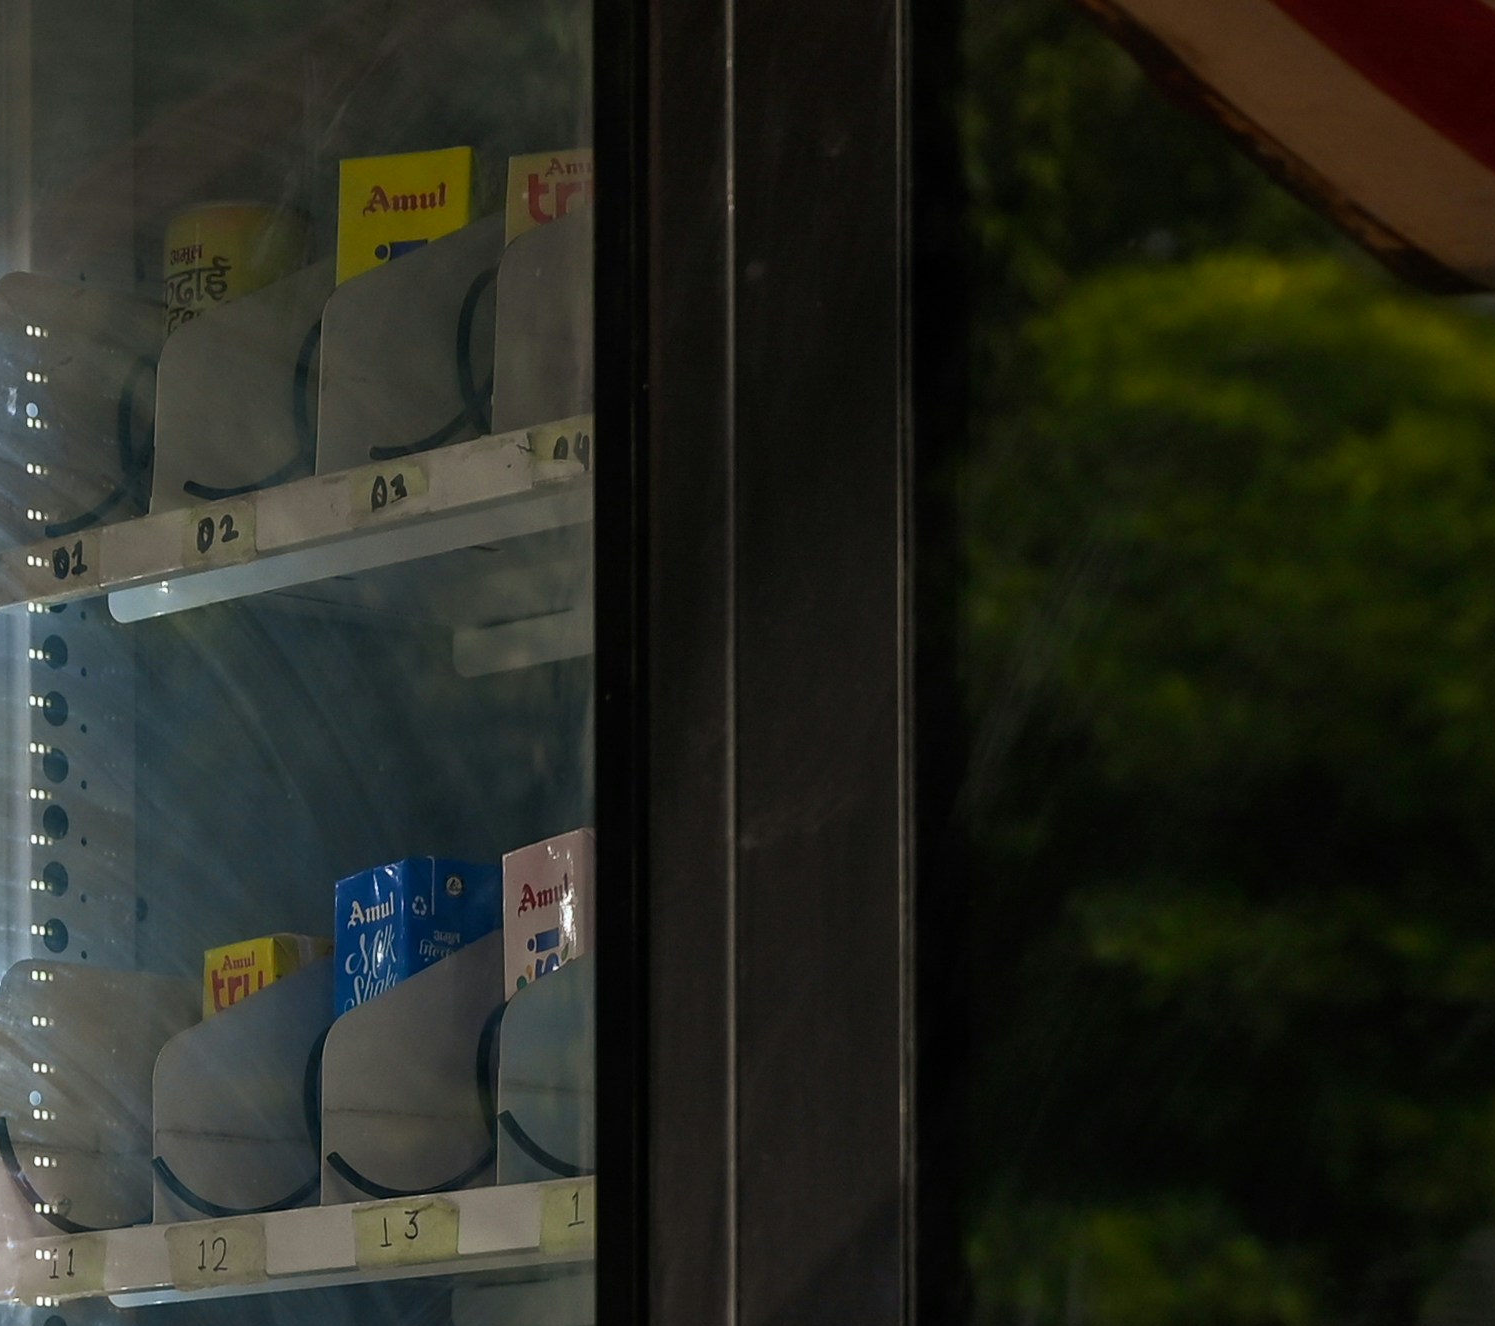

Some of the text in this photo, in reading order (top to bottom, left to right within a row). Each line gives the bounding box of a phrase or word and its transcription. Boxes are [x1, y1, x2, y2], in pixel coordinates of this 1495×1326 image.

[363, 182, 447, 217] Amul
[528, 173, 593, 224] tr
[370, 473, 409, 512] 03
[195, 514, 240, 553] 02
[52, 539, 88, 579] 01
[347, 890, 395, 930] Amul
[220, 949, 256, 971] Amul
[344, 923, 397, 979] Milk
[379, 1210, 421, 1248] 13
[48, 1247, 75, 1280] 11
[197, 1236, 229, 1272] 12
